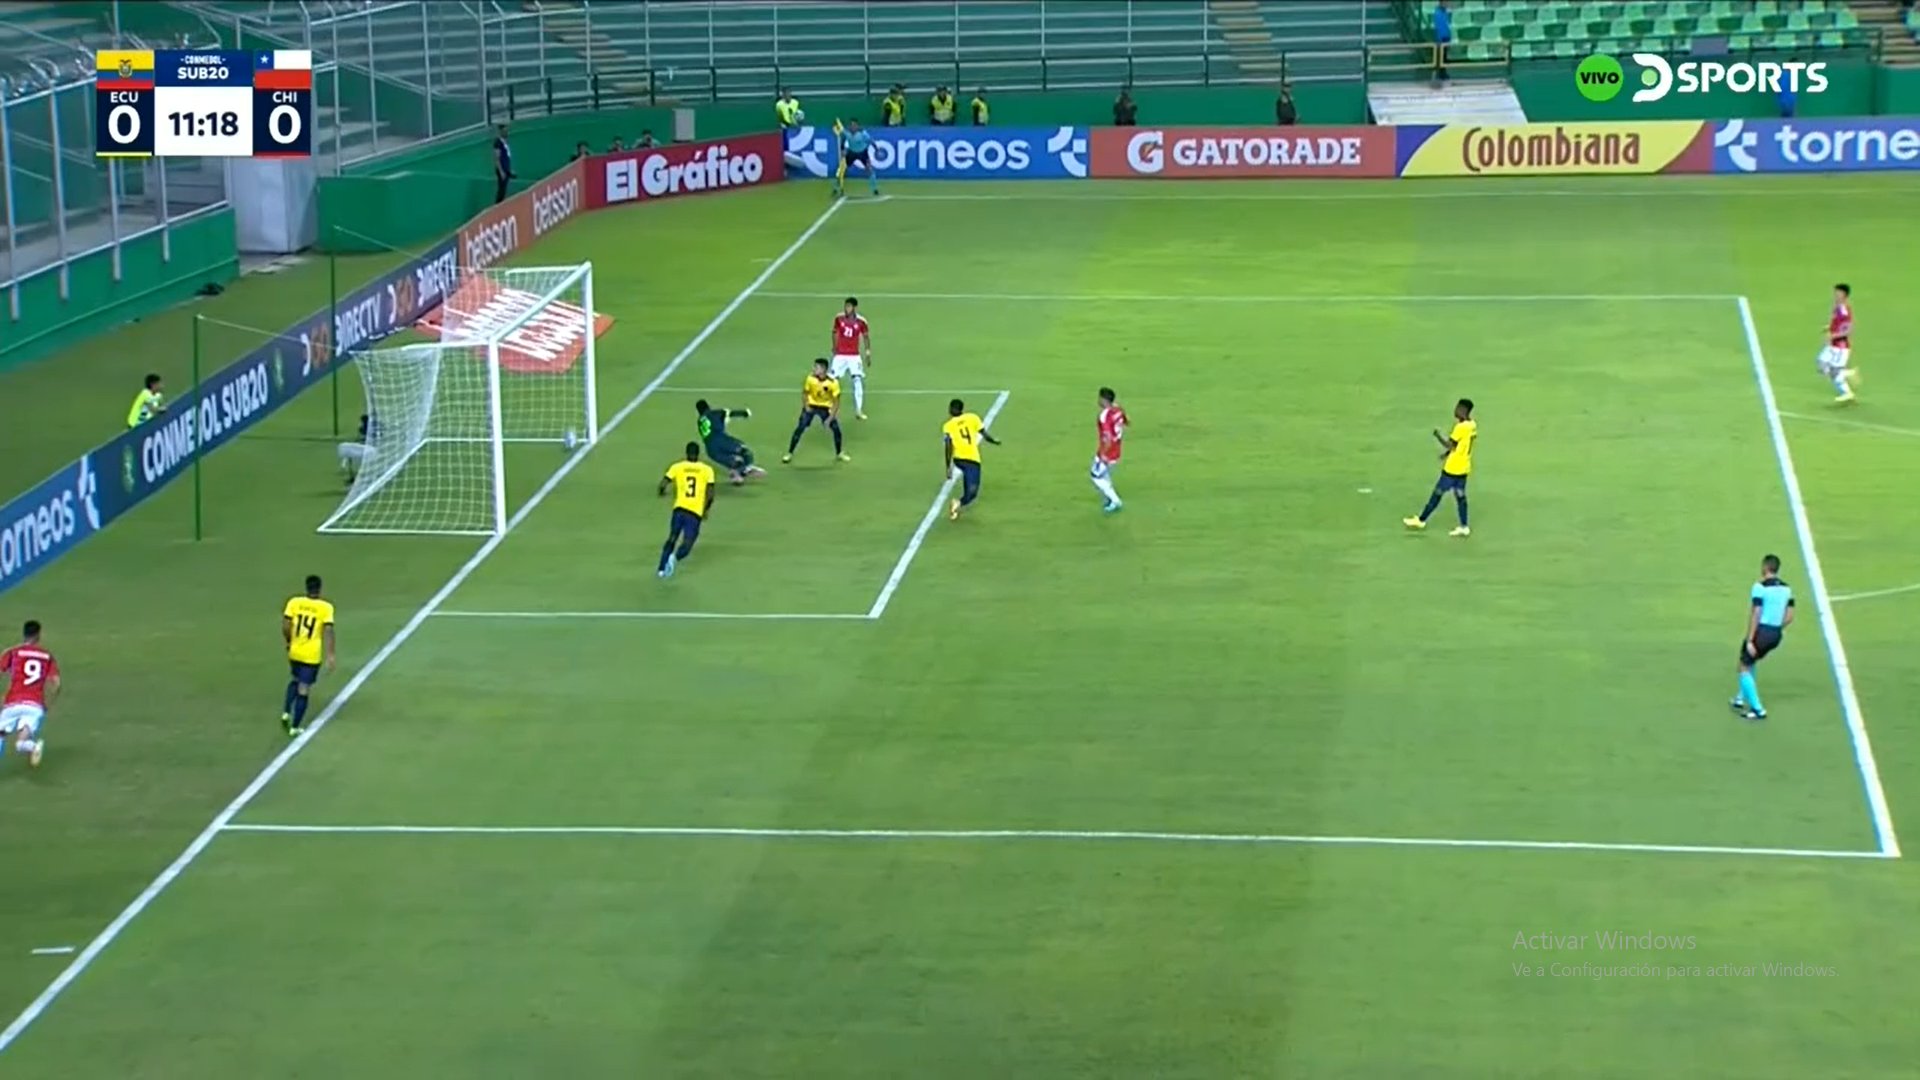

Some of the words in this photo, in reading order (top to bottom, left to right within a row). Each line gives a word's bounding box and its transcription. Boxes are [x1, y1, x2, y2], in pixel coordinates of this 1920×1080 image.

[853, 139, 1030, 170] orneos
[1172, 137, 1361, 166] GATORADE
[1462, 127, 1640, 172] Colombiana
[1774, 125, 1920, 163] torne
[606, 158, 637, 202] El
[641, 144, 762, 196] Gráfico
[532, 178, 578, 235] betsson
[465, 215, 518, 274] betsson
[142, 393, 222, 483] CONMEOL
[221, 362, 268, 429] SUB20
[959, 426, 972, 446] 4
[685, 476, 697, 498] 3
[0, 489, 76, 578] orneos
[296, 614, 316, 640] 14
[23, 659, 42, 686] 9
